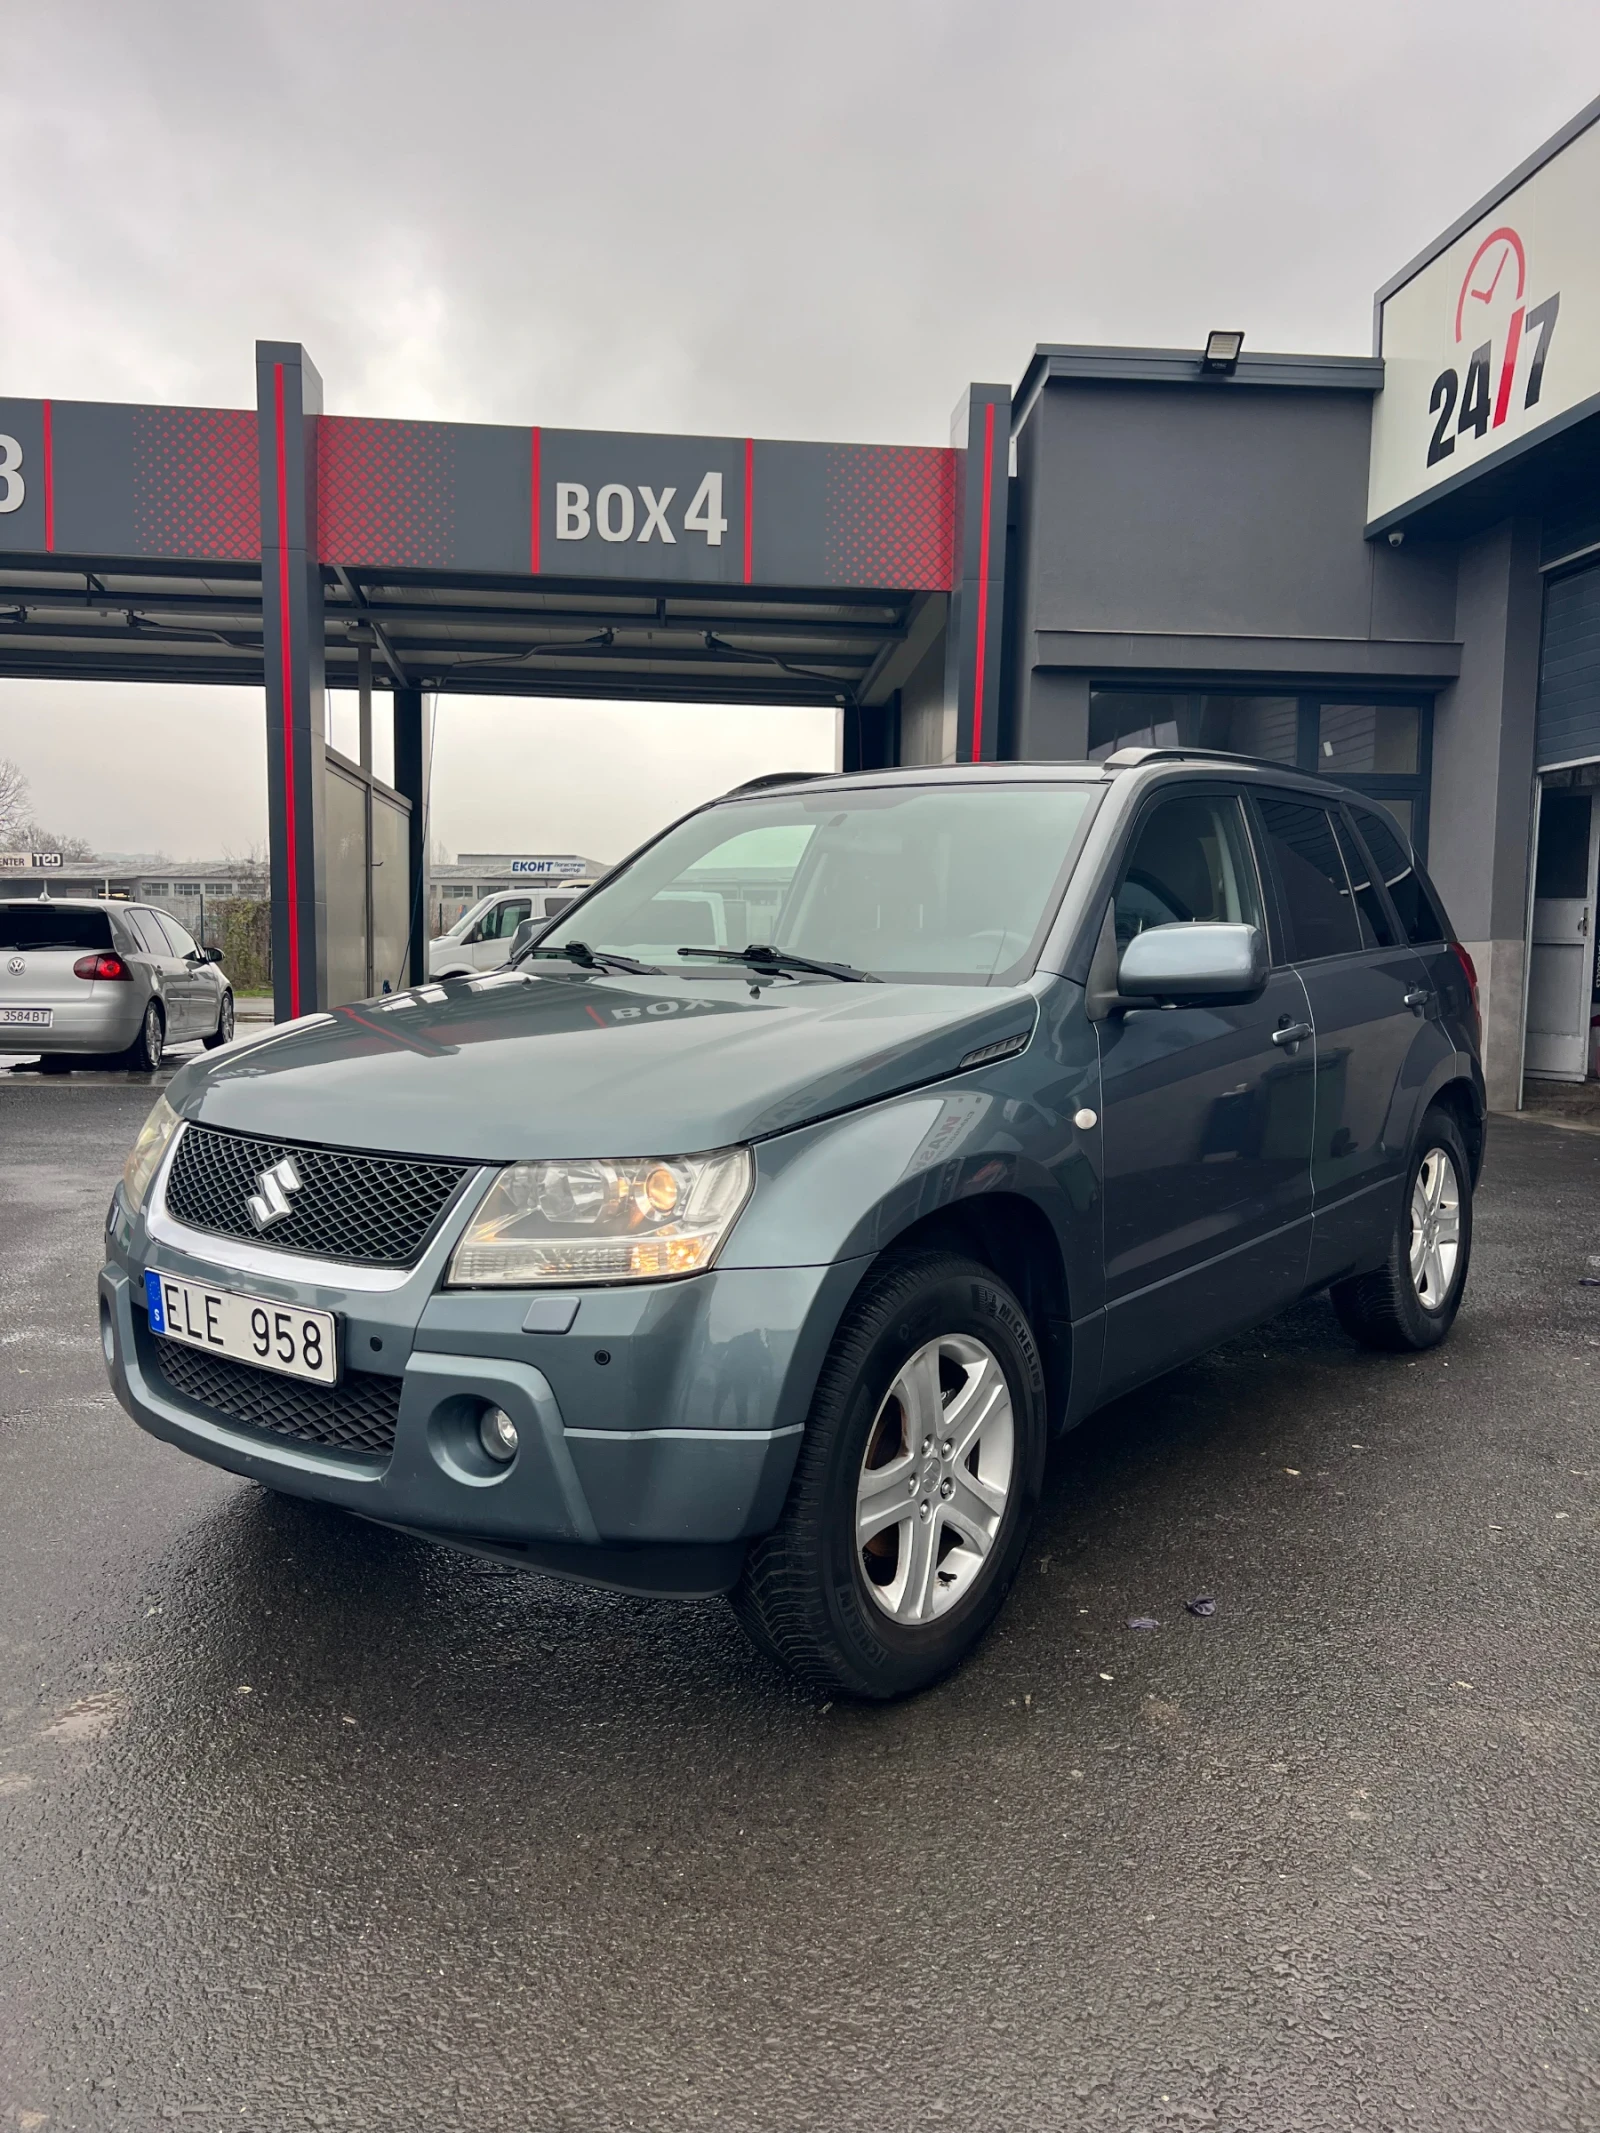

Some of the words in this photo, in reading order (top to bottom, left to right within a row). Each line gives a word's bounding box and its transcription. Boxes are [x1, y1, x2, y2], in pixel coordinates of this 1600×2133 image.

[1426, 290, 1561, 469] 24/7
[512, 861, 554, 872] ЕКОНТ
[3, 1010, 30, 1021] 3584
[32, 1011, 48, 1022] BT
[154, 1308, 160, 1322] S
[164, 1283, 224, 1346] ELE
[251, 1307, 323, 1370] 958
[998, 1303, 1042, 1388] MICHELIN
[839, 1590, 889, 1668] ICHELIN
